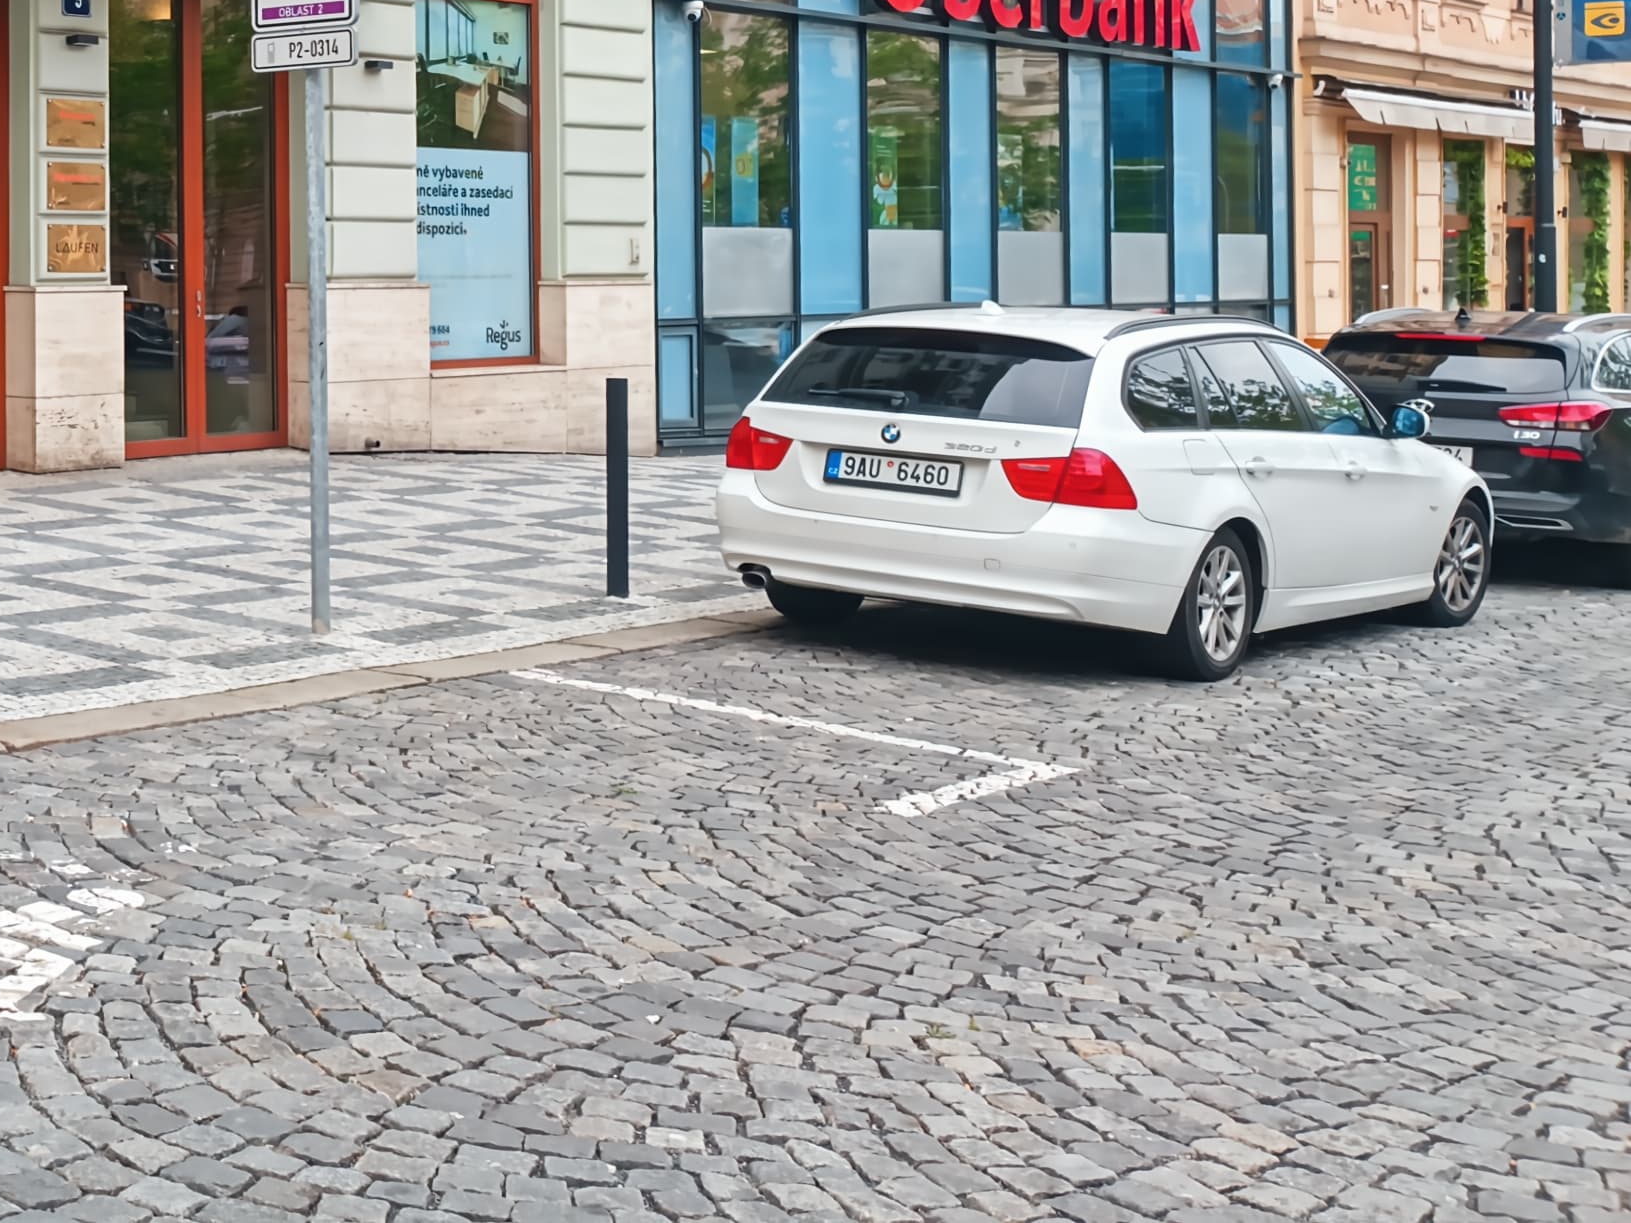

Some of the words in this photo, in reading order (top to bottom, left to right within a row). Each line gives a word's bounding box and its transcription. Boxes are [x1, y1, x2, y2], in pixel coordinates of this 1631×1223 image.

[278, 4, 315, 17] OBLAST
[317, 3, 324, 15] 2
[288, 38, 339, 59] P2-0314
[431, 164, 484, 182] vybavené
[417, 183, 459, 198] nceláře
[461, 188, 468, 198] a
[469, 185, 514, 200] zasedací
[417, 201, 459, 216] ístnosti
[460, 202, 490, 217] ihned
[55, 241, 99, 255] LAUFEN
[485, 324, 522, 351] Regus
[843, 456, 882, 479] 9AU
[896, 461, 950, 486] 6460
